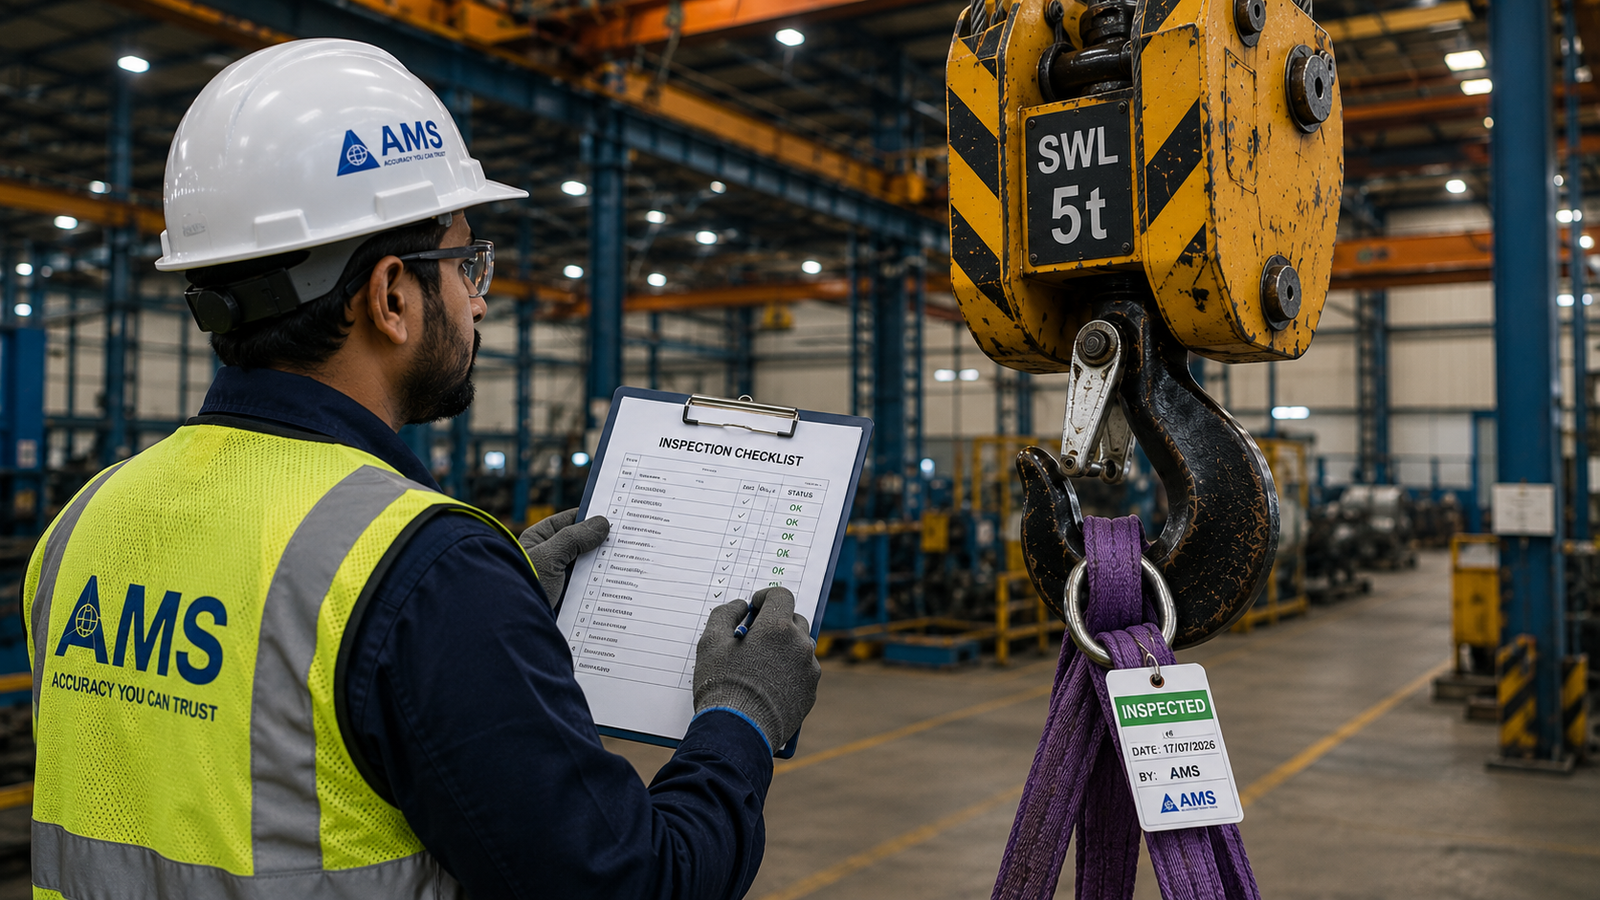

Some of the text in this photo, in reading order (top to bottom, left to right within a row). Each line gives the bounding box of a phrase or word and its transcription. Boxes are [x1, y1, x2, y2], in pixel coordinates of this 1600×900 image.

[382, 120, 443, 156] AMS
[1038, 126, 1119, 174] SWL
[1051, 184, 1107, 244] 5t
[659, 437, 804, 467] INSPECTION CHECKLIST
[788, 489, 814, 499] STATUS
[789, 504, 803, 512] OK
[786, 518, 799, 526] OK
[781, 532, 795, 541] OK
[776, 548, 790, 558] OK
[772, 566, 785, 575] OK
[55, 575, 227, 685] AMS
[52, 671, 218, 722] ACCURACY YOU CAN TRUST
[1121, 698, 1206, 719] INSPECTED
[1132, 740, 1216, 757] DATE: 17/07/2026
[1139, 765, 1200, 782] BY: AMS
[1180, 790, 1217, 807] AMS
